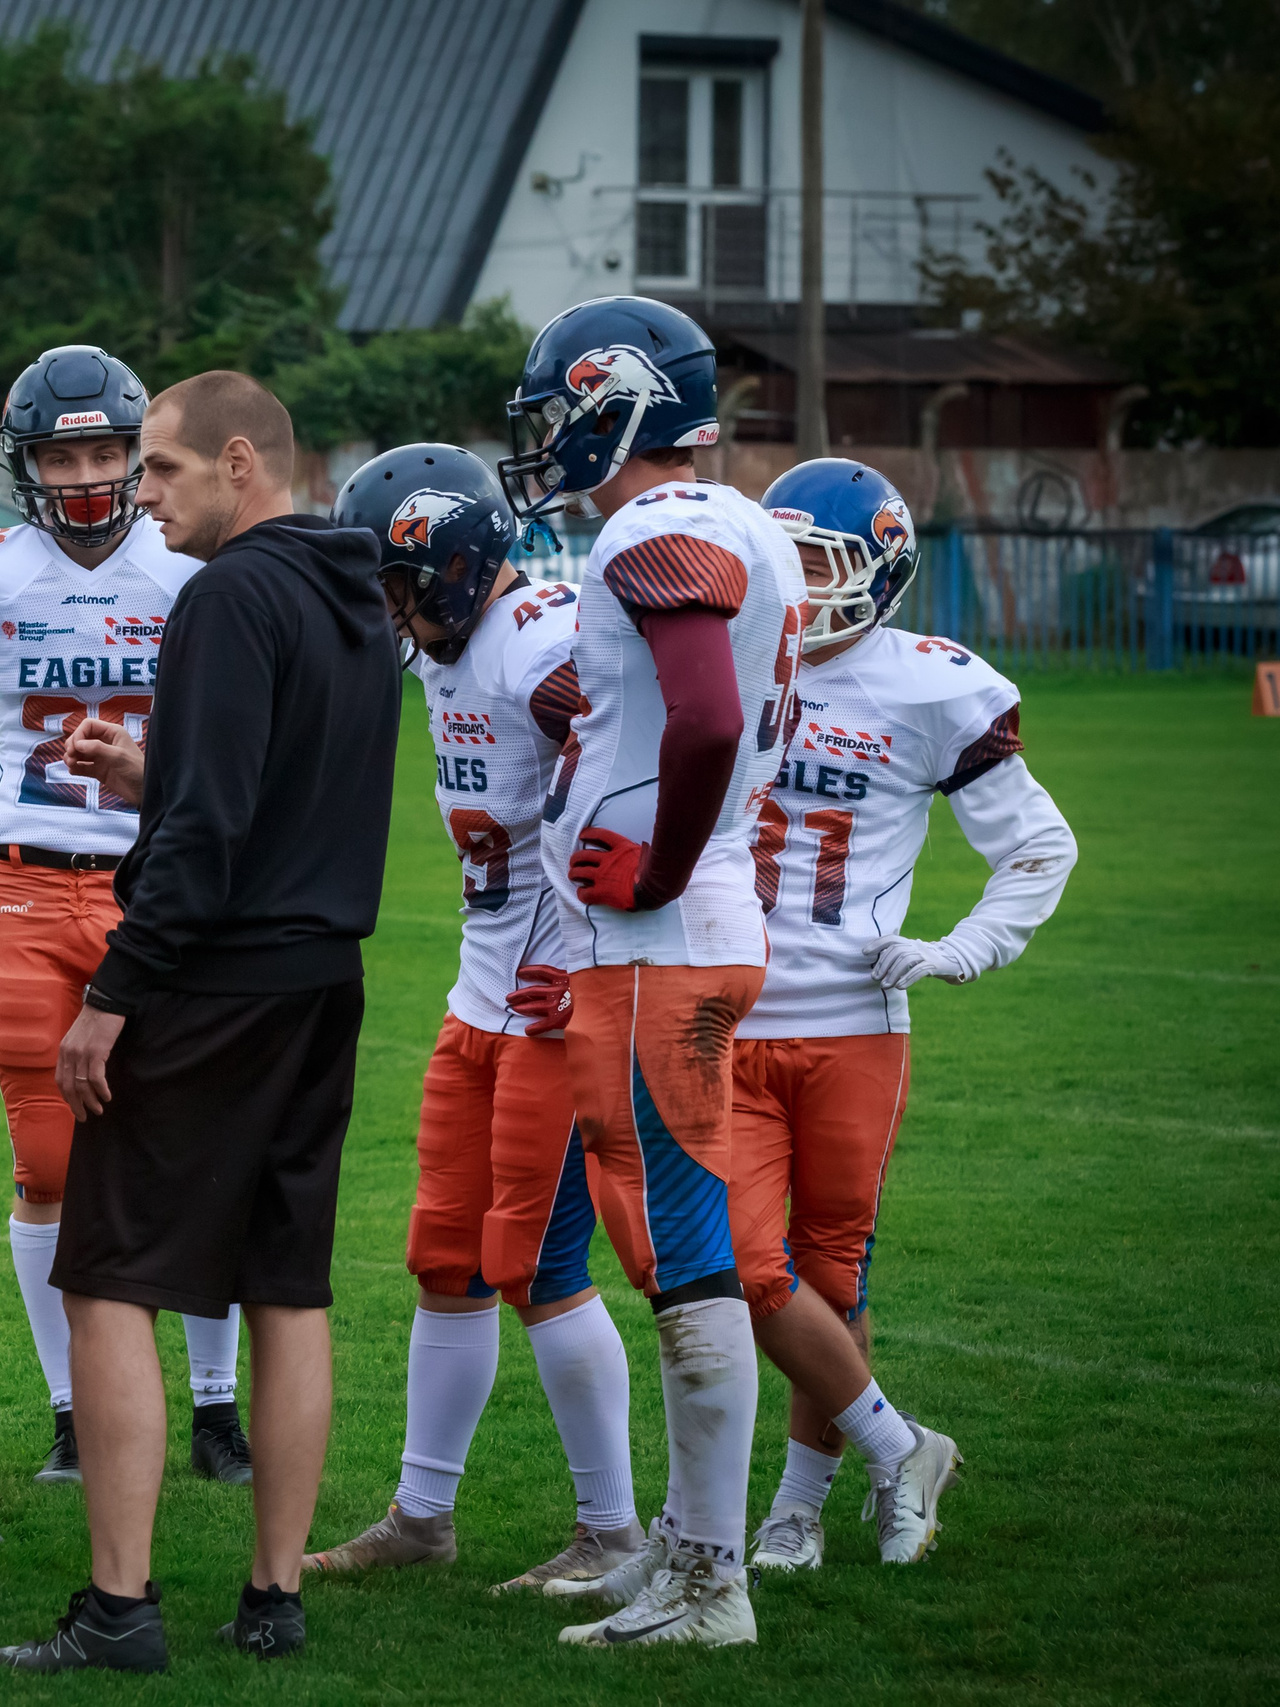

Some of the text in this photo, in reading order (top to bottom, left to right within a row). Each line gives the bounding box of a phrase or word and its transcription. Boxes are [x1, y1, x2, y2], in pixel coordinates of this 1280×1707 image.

[61, 413, 103, 426] Riddell
[772, 509, 802, 521] Riddell
[512, 583, 578, 632] 49
[18, 627, 75, 636] Management
[453, 723, 486, 735] FRIDAYS
[824, 735, 881, 753] FRIDAYS
